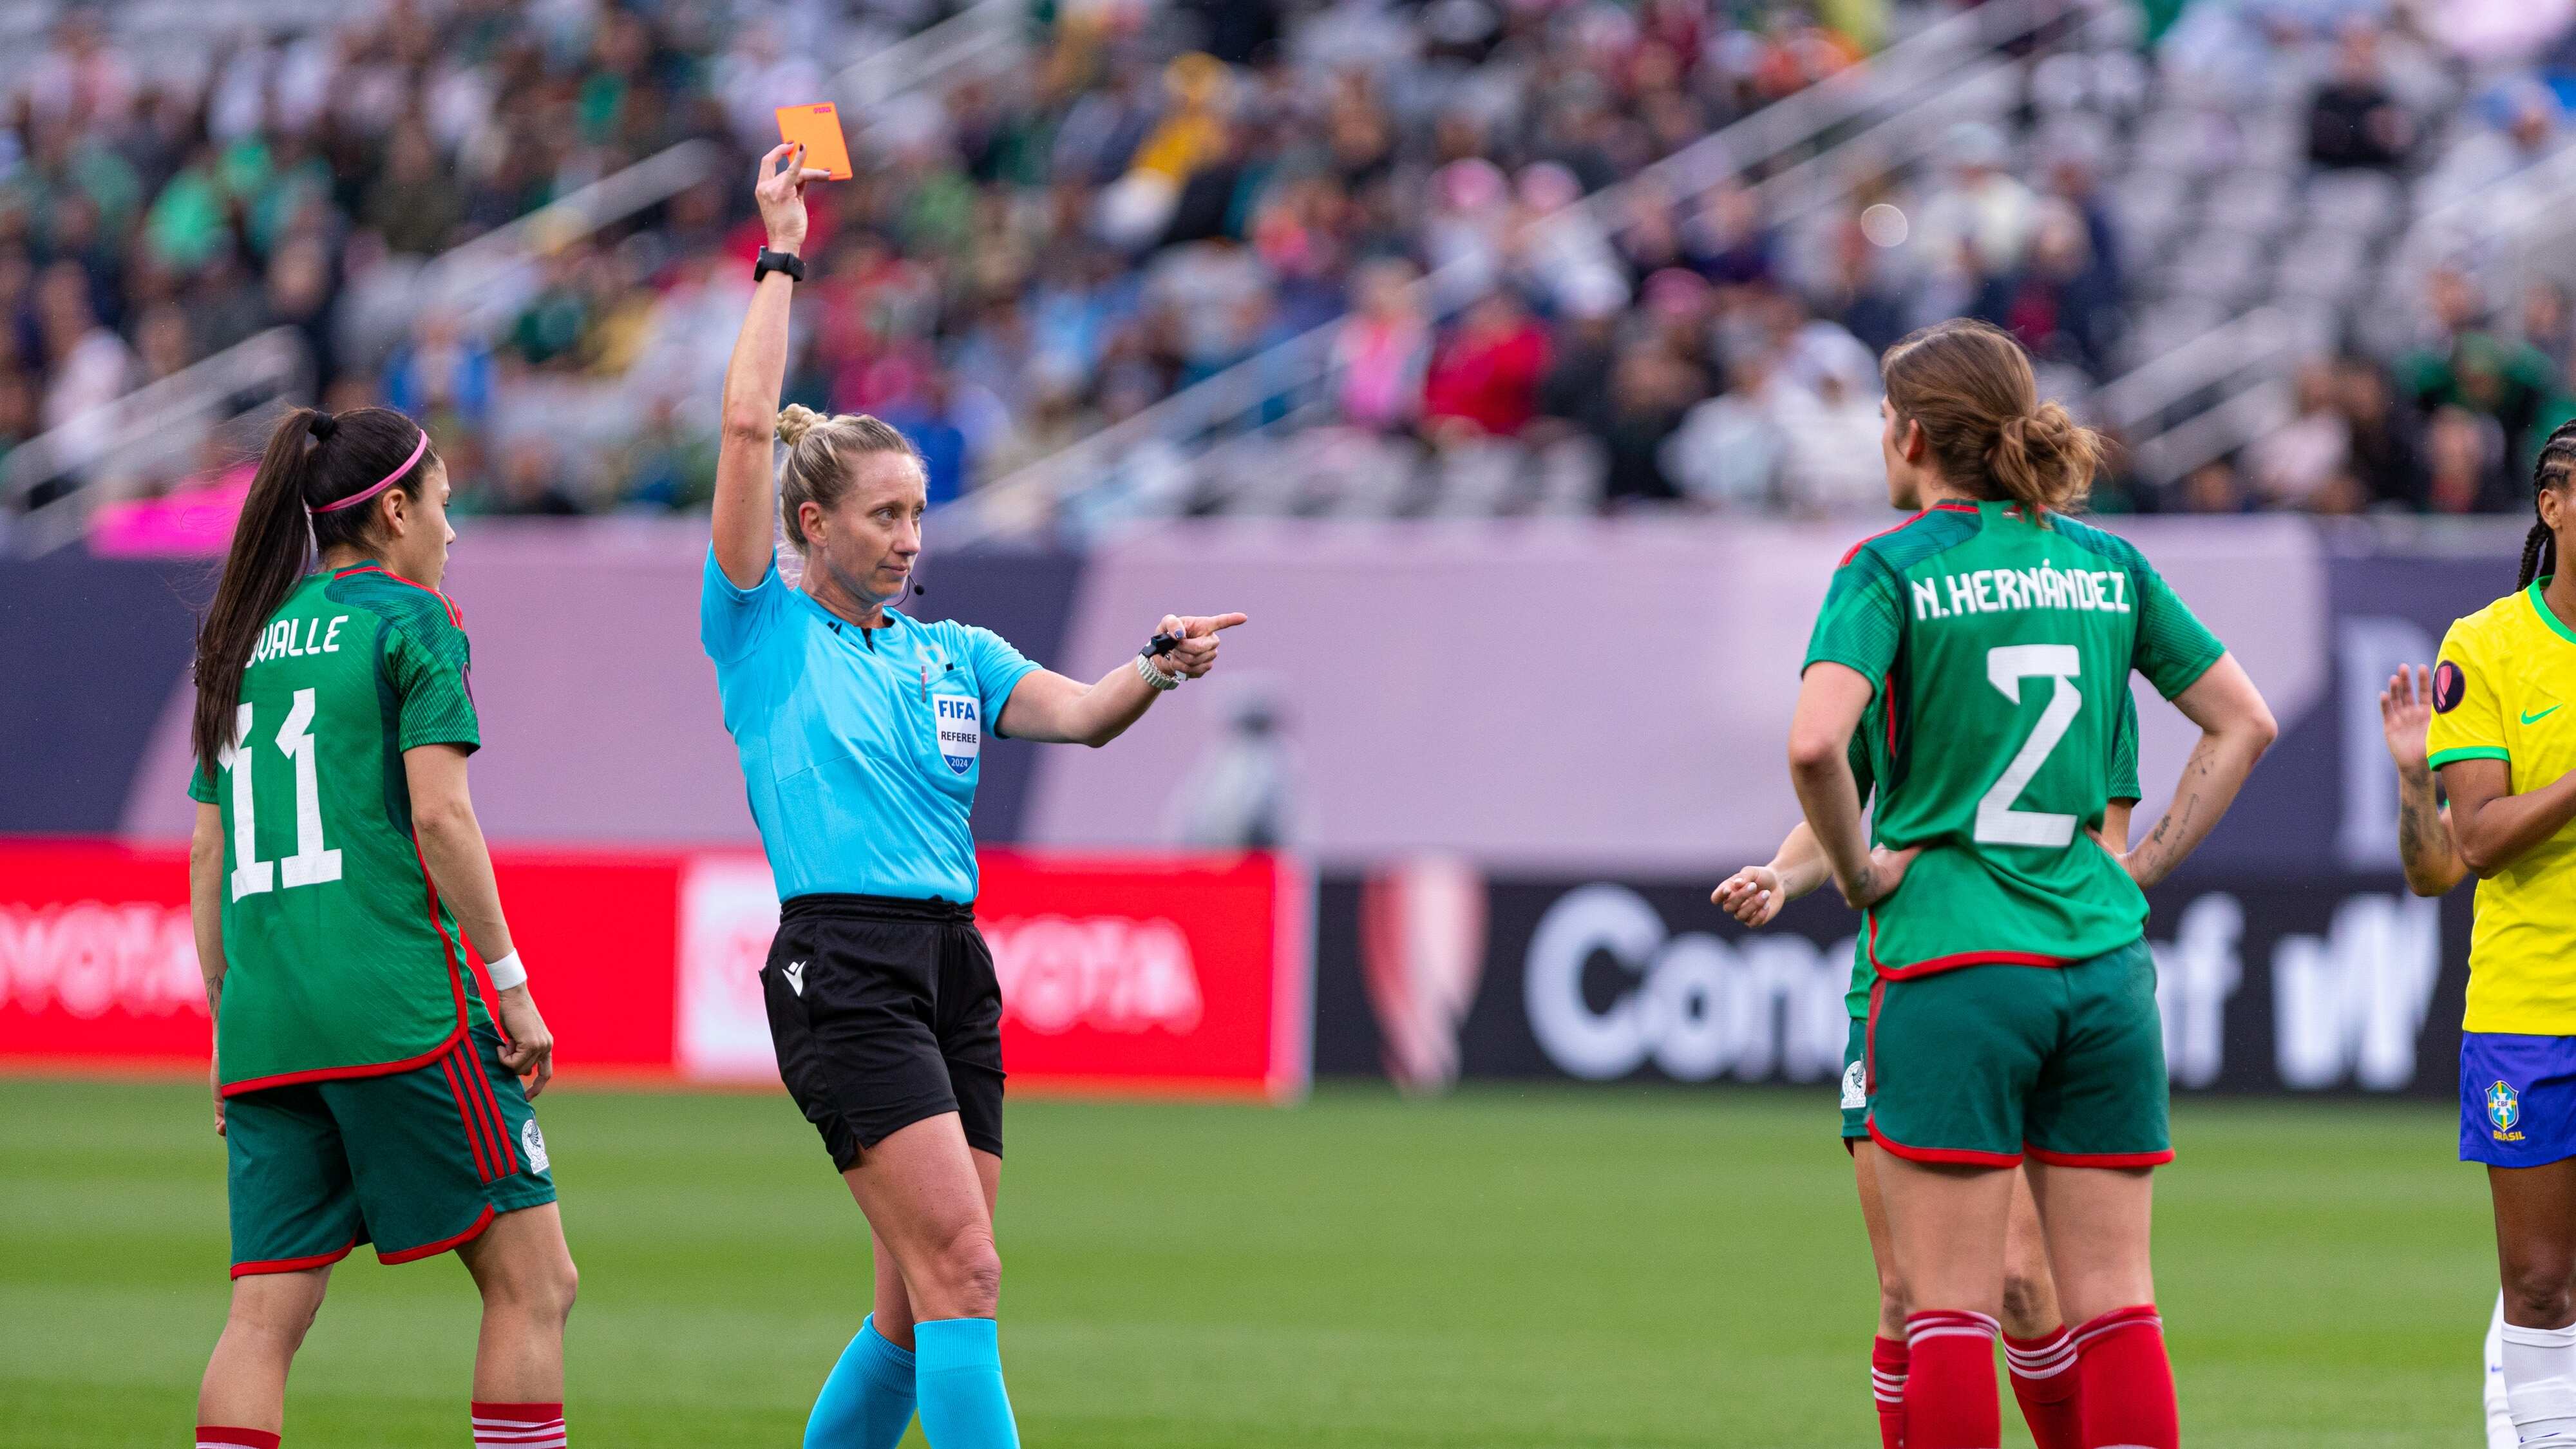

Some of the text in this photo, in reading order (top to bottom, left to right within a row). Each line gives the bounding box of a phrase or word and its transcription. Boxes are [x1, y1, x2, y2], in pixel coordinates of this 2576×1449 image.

[1911, 558, 2130, 620] N.HERNÁNDEZ
[938, 699, 976, 721] FIFA
[941, 730, 977, 744] REFEREE
[1973, 644, 2082, 848] 2
[951, 757, 968, 768] 2024
[217, 687, 343, 904] 11
[2493, 1130, 2525, 1141] BRASIL
